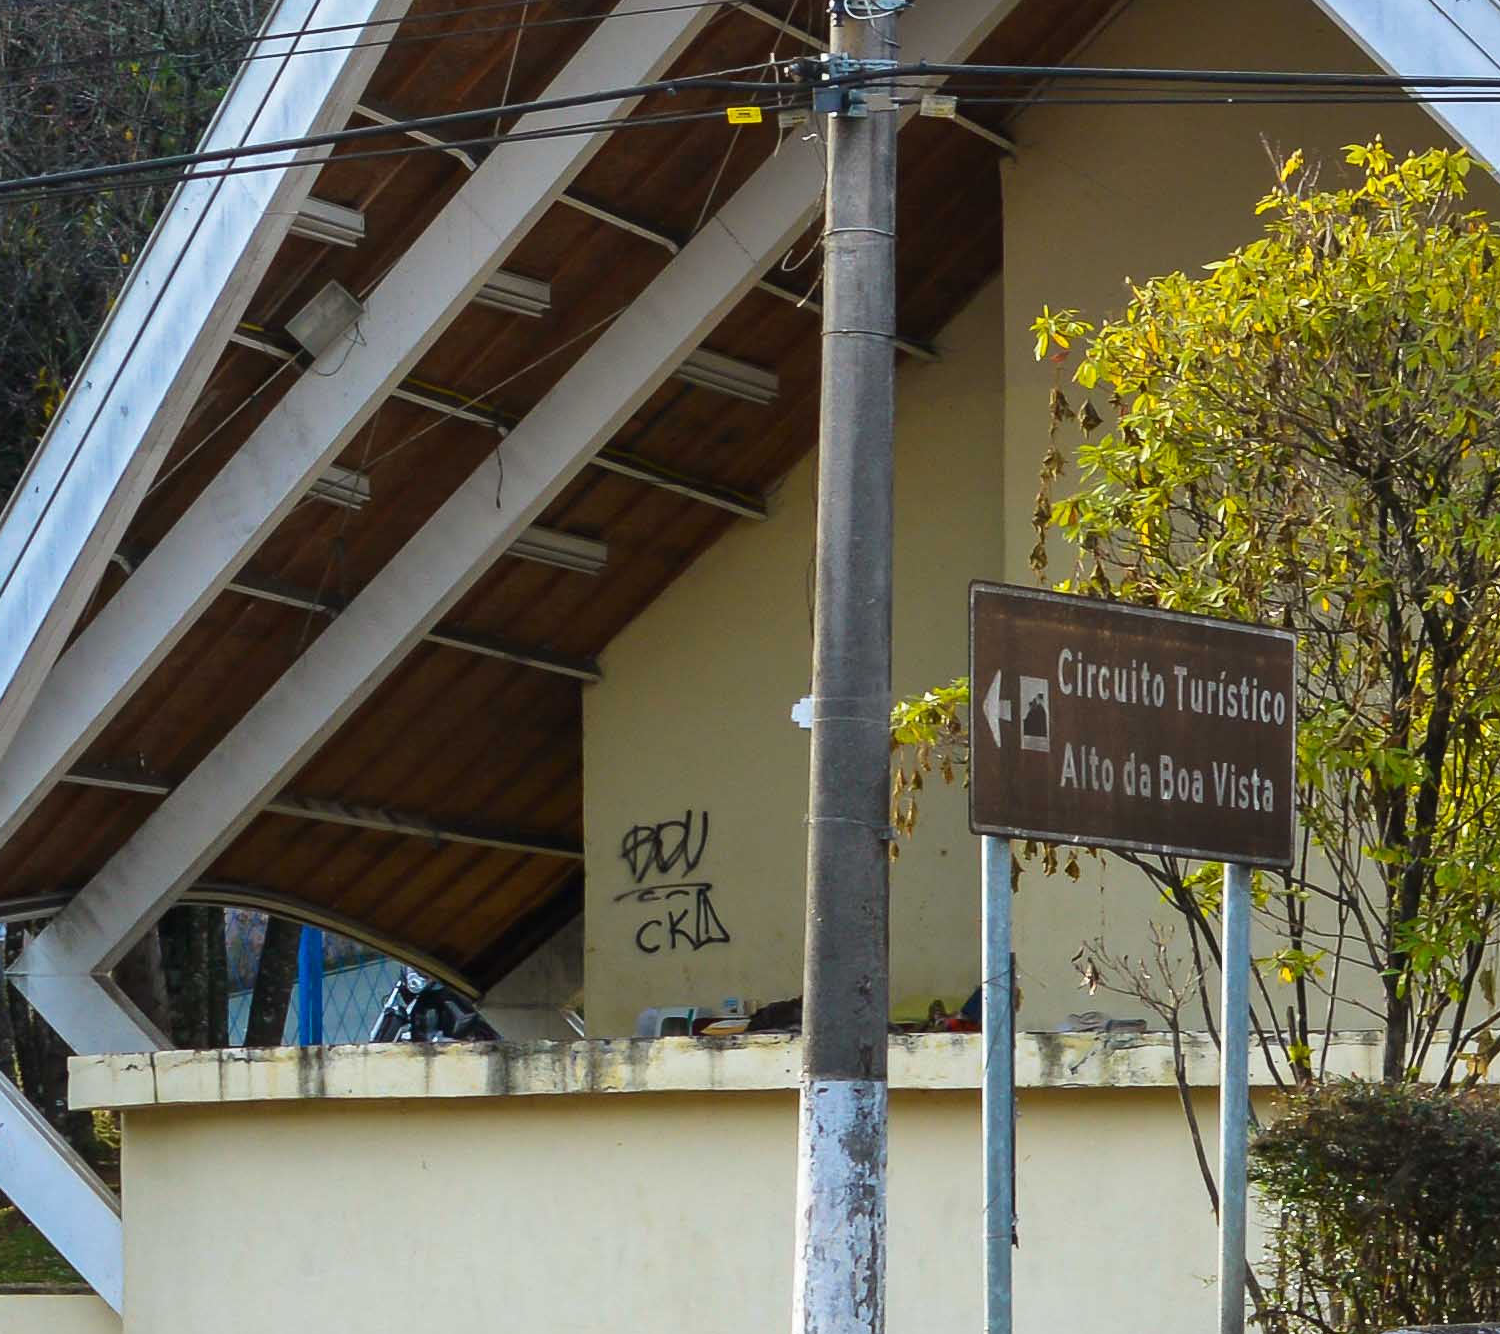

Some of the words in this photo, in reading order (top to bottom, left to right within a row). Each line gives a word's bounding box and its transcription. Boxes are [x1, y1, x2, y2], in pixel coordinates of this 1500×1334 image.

[1057, 647, 1165, 708] Circuito
[1173, 665, 1286, 726] Turístico
[1059, 742, 1115, 793] Alto
[1122, 751, 1152, 798] da
[1159, 754, 1204, 804] Boa
[1211, 760, 1275, 812] Vista
